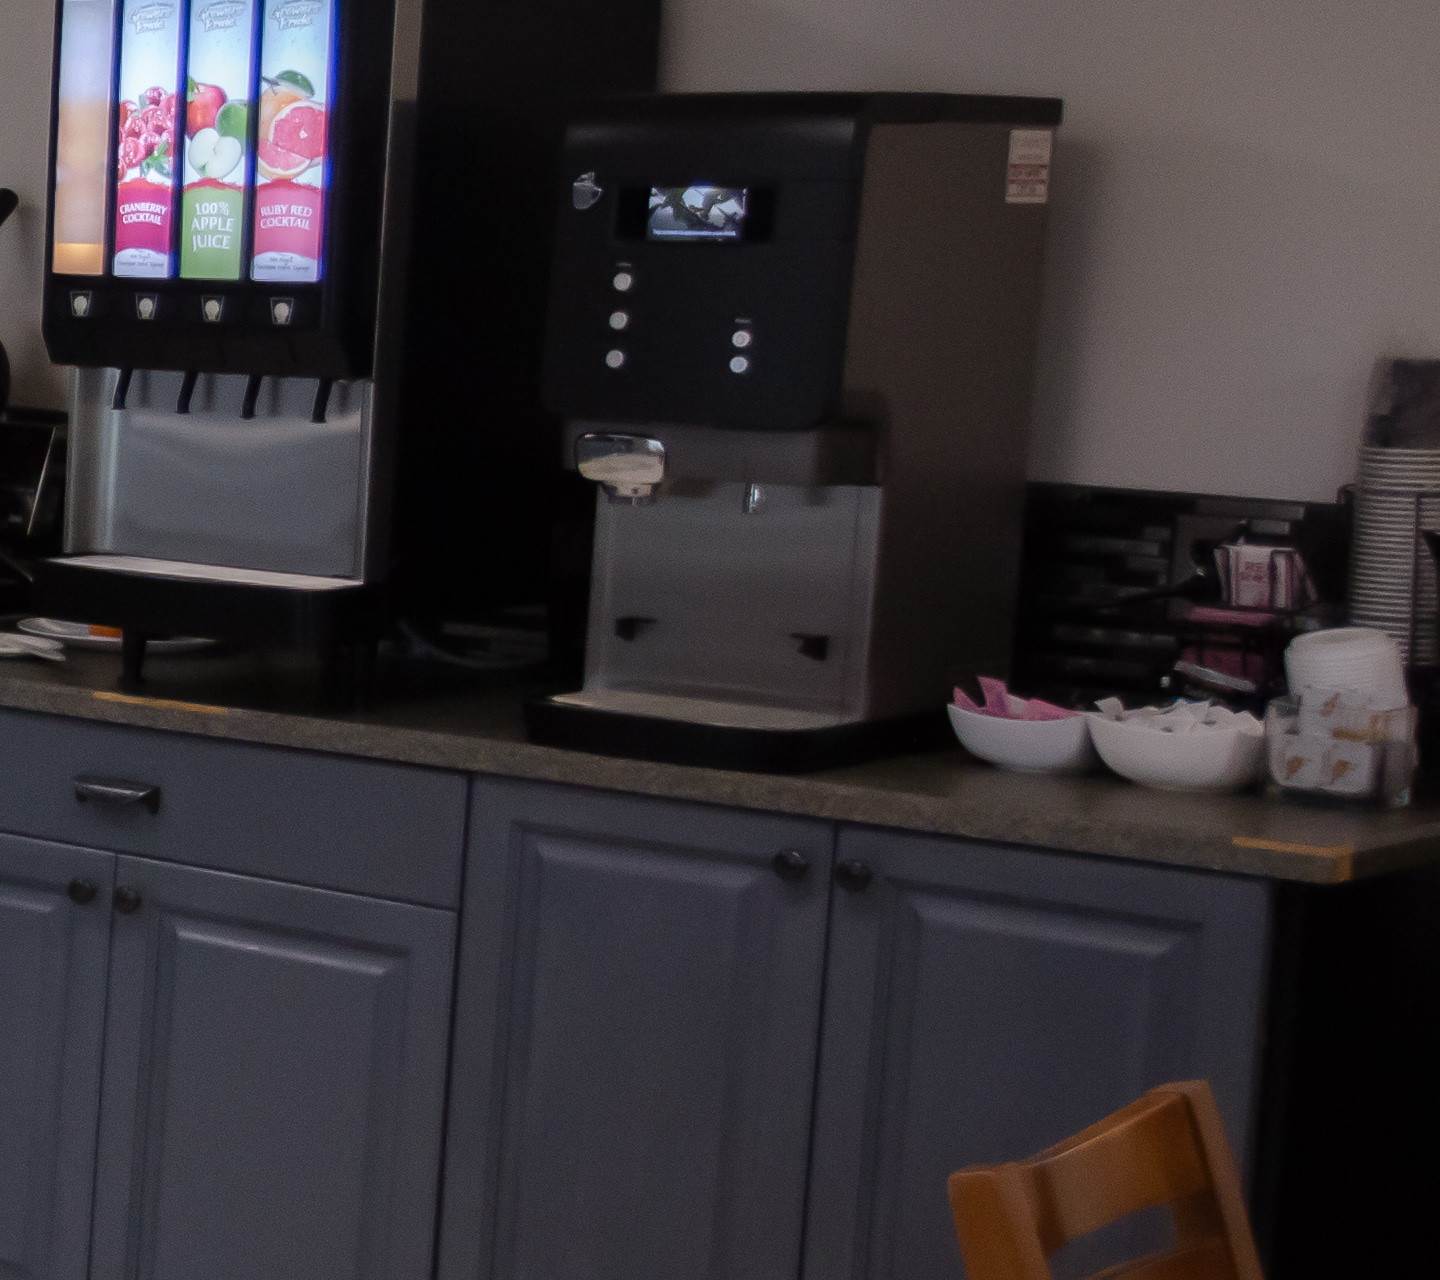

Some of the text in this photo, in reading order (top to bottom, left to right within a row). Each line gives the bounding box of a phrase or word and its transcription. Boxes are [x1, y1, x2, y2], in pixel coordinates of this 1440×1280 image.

[119, 202, 168, 216] CRANBERRY
[194, 201, 230, 217] 100%
[260, 204, 313, 218] RUBY RED
[122, 213, 163, 226] COCKTAIL
[191, 216, 235, 232] APPLE
[260, 216, 311, 231] COCKTAIL
[192, 234, 231, 252] JUICE
